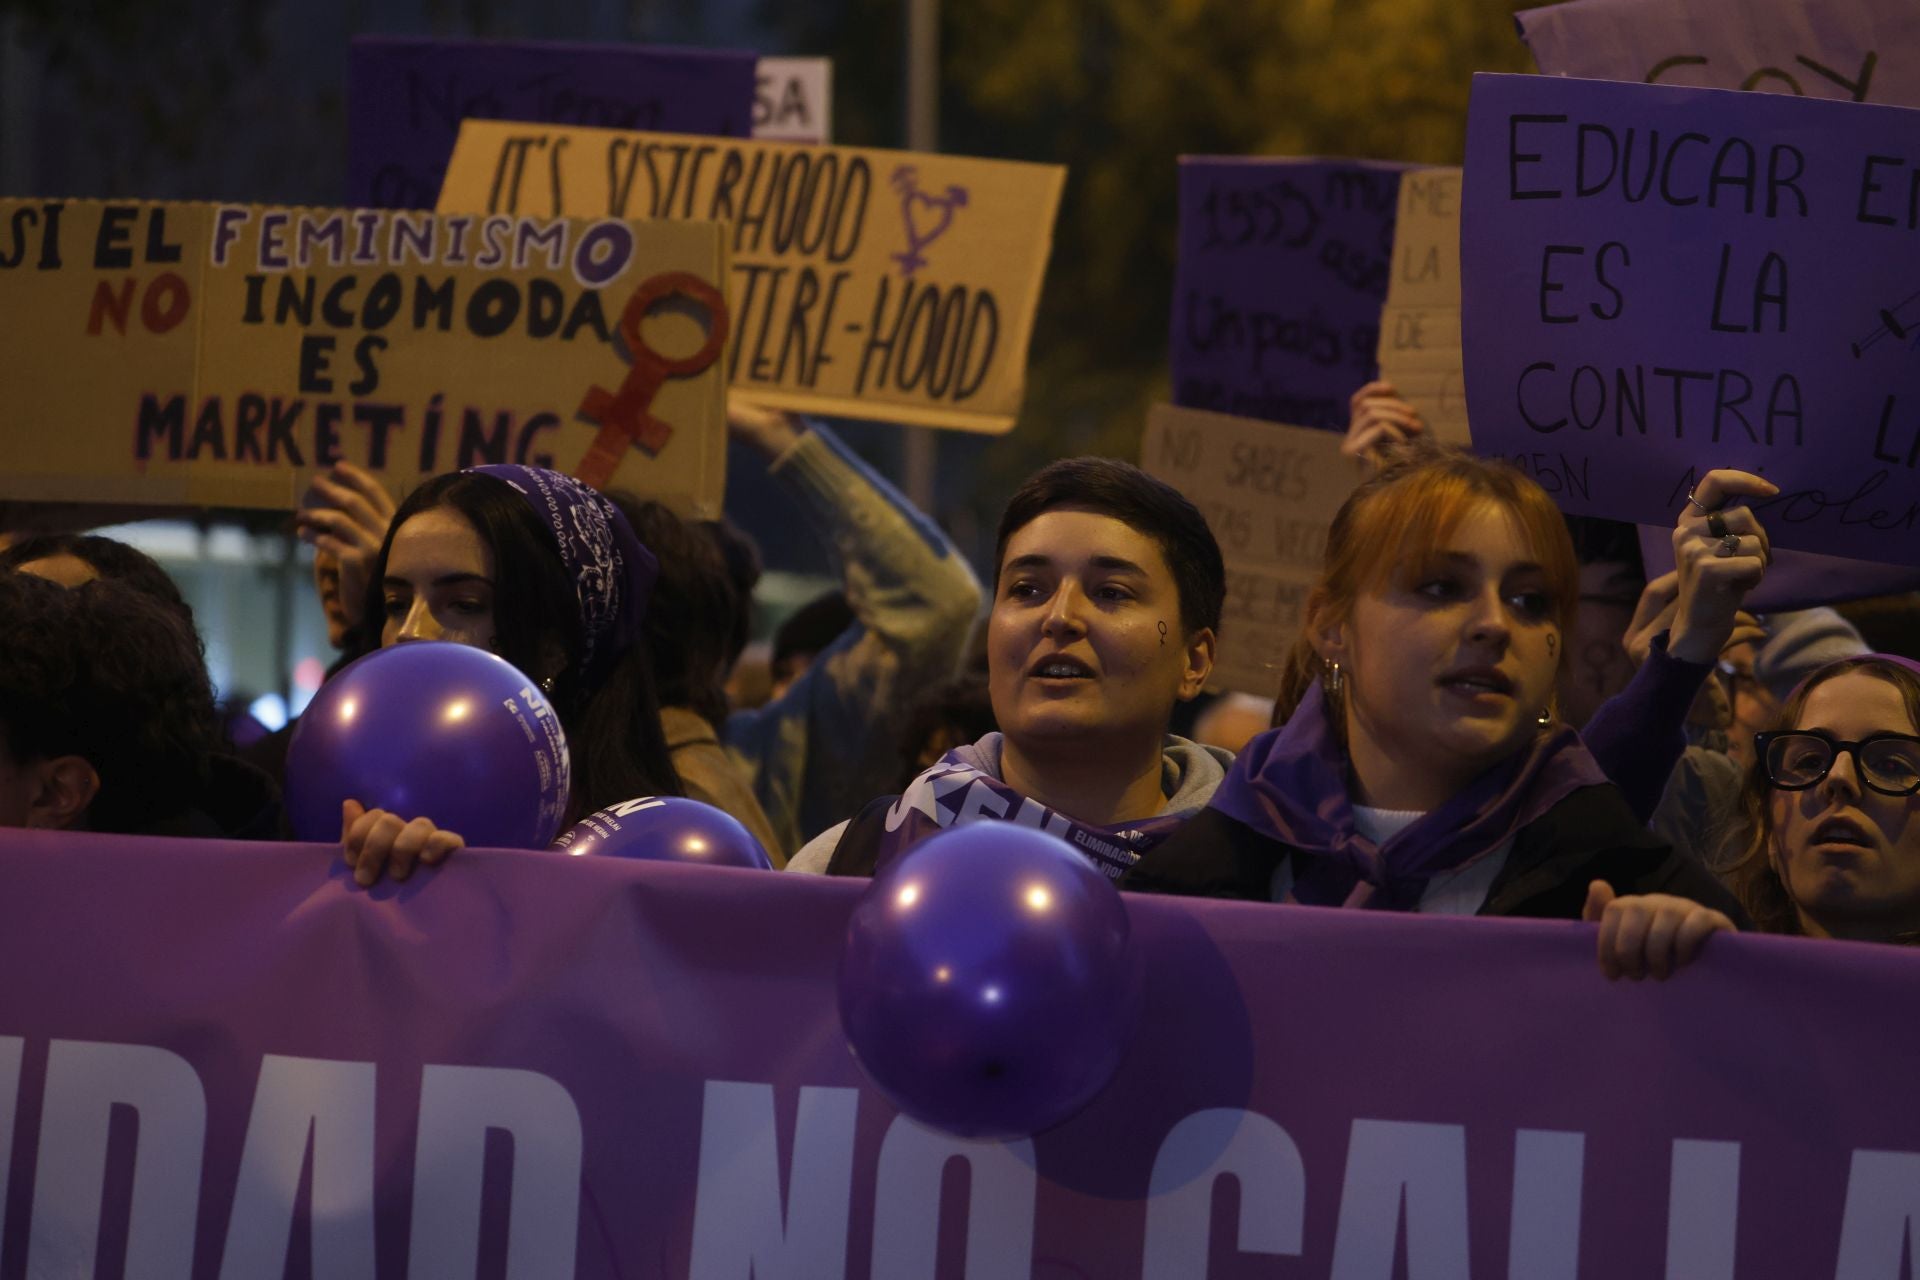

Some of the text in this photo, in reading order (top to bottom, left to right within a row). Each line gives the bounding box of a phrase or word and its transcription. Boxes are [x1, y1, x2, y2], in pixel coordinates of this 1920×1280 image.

[1509, 114, 1808, 218] EDUCAR
[0, 203, 636, 289] SI EL FEMINISMO
[1539, 241, 1788, 333] ES LA
[86, 272, 612, 342] NO INCOMODA
[299, 335, 388, 397] ES
[1517, 361, 1804, 446] CONTRA
[1493, 452, 1591, 501] 5N
